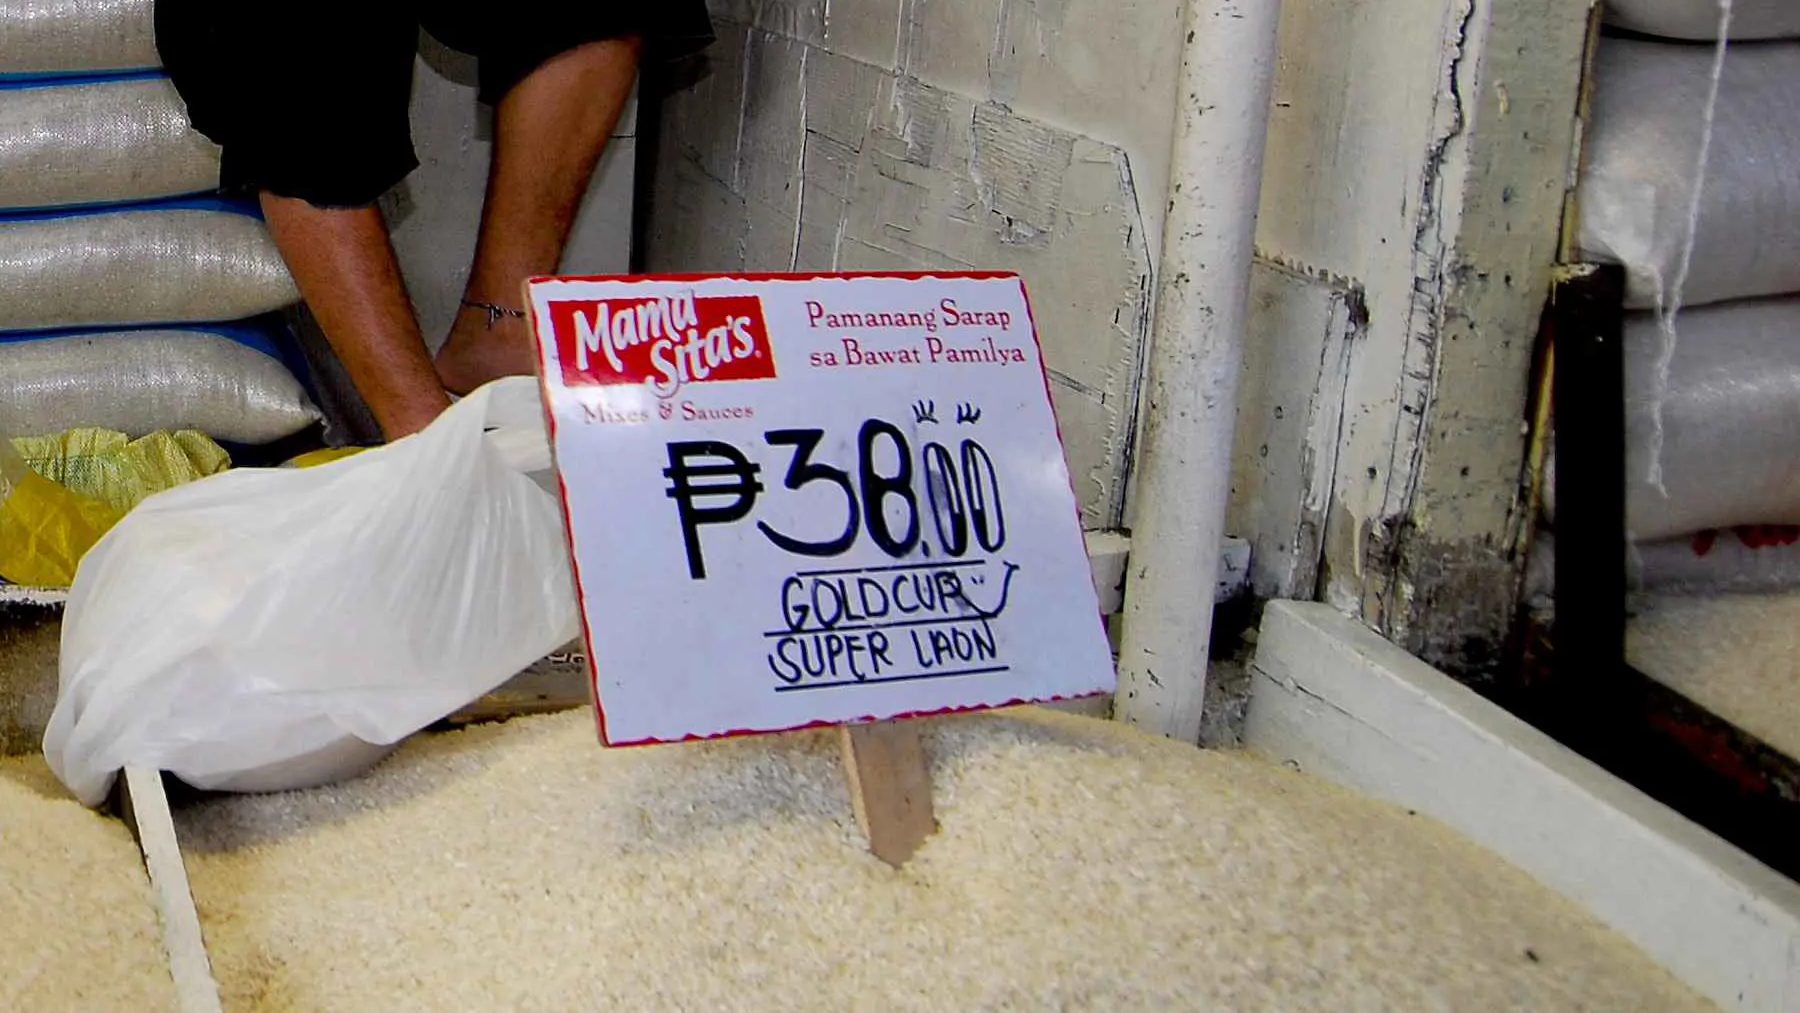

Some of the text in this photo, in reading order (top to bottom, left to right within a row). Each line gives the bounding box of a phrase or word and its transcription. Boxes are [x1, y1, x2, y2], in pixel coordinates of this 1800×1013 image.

[572, 290, 698, 373] Mama
[805, 297, 1011, 332] Pamanang Sarap
[647, 315, 758, 397] Sita's
[810, 336, 1026, 366] sa Bawat Pamilya
[582, 400, 755, 424] Mixes & Sauces
[767, 625, 997, 683] SUPER LAON
